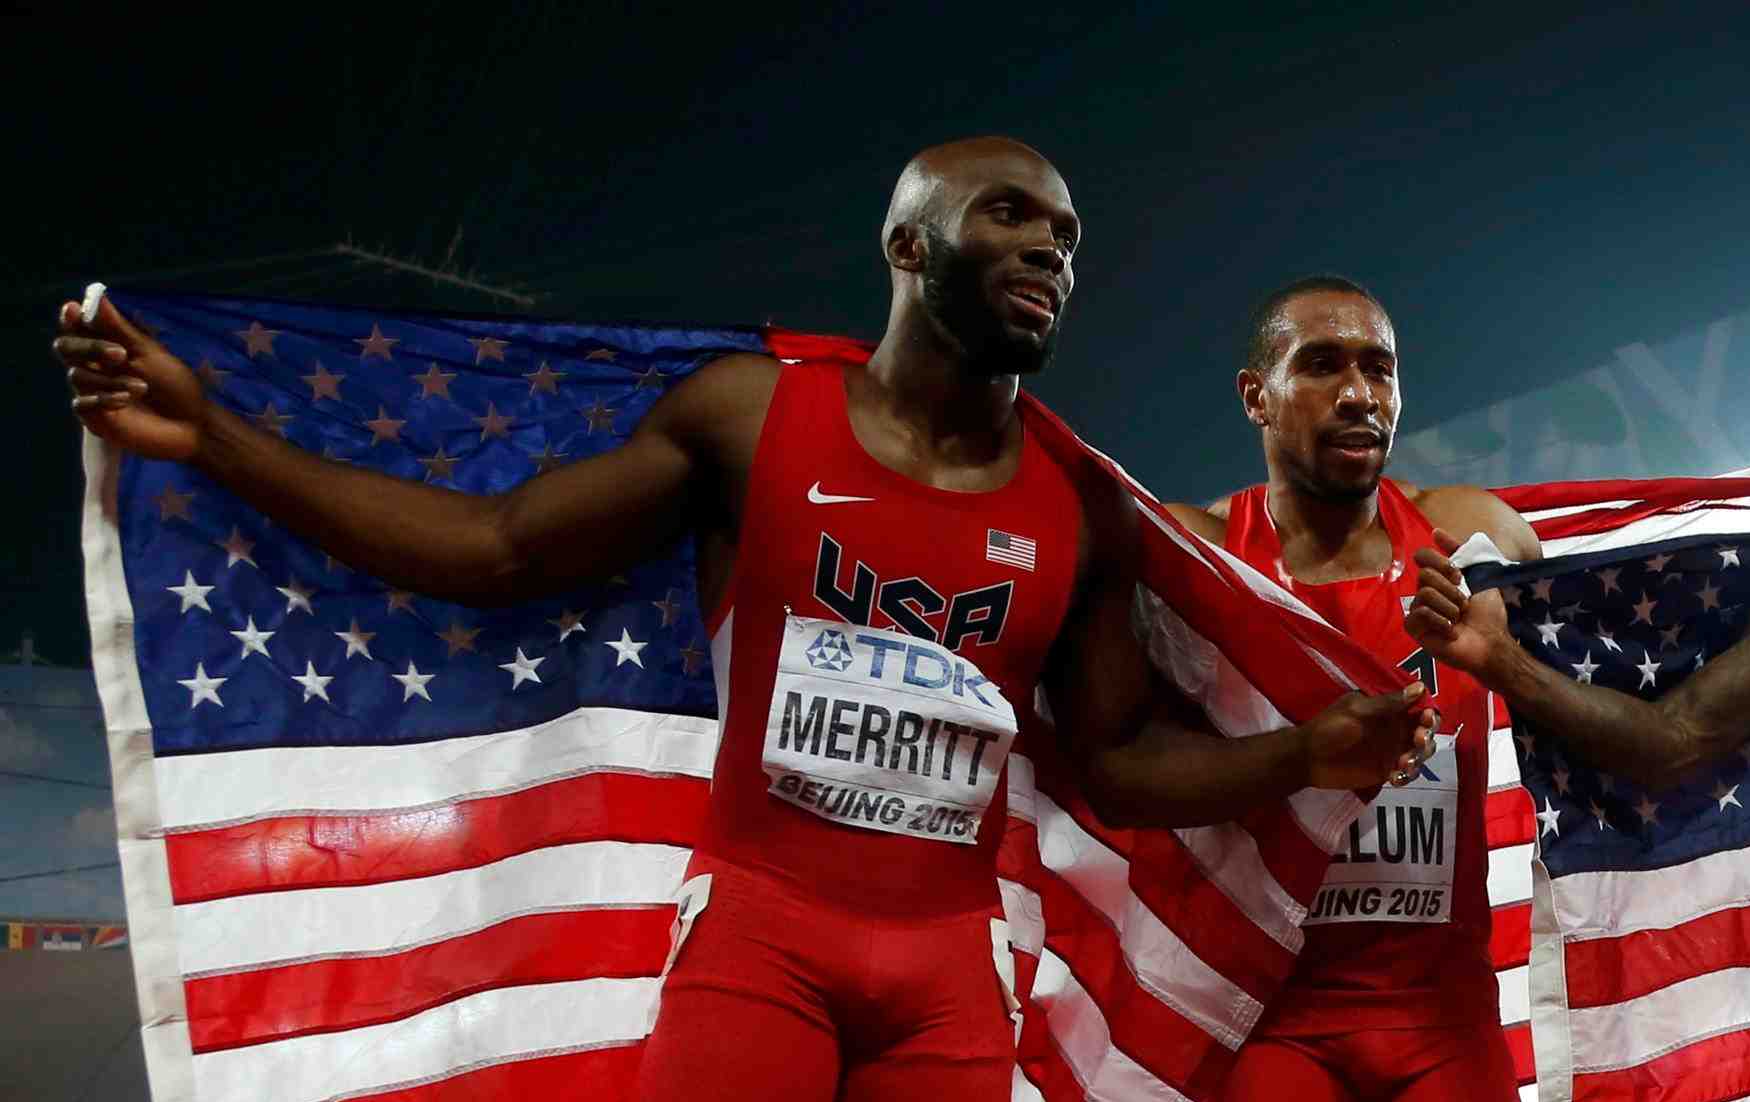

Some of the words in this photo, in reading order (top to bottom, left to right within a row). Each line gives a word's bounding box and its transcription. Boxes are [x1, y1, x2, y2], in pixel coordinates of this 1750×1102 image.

[813, 531, 1014, 652] USA
[855, 634, 995, 708] TDK
[778, 691, 1000, 786] MERRITT
[776, 773, 905, 825] BEIJING
[906, 803, 970, 837] 2015
[1386, 889, 1444, 916] 2015
